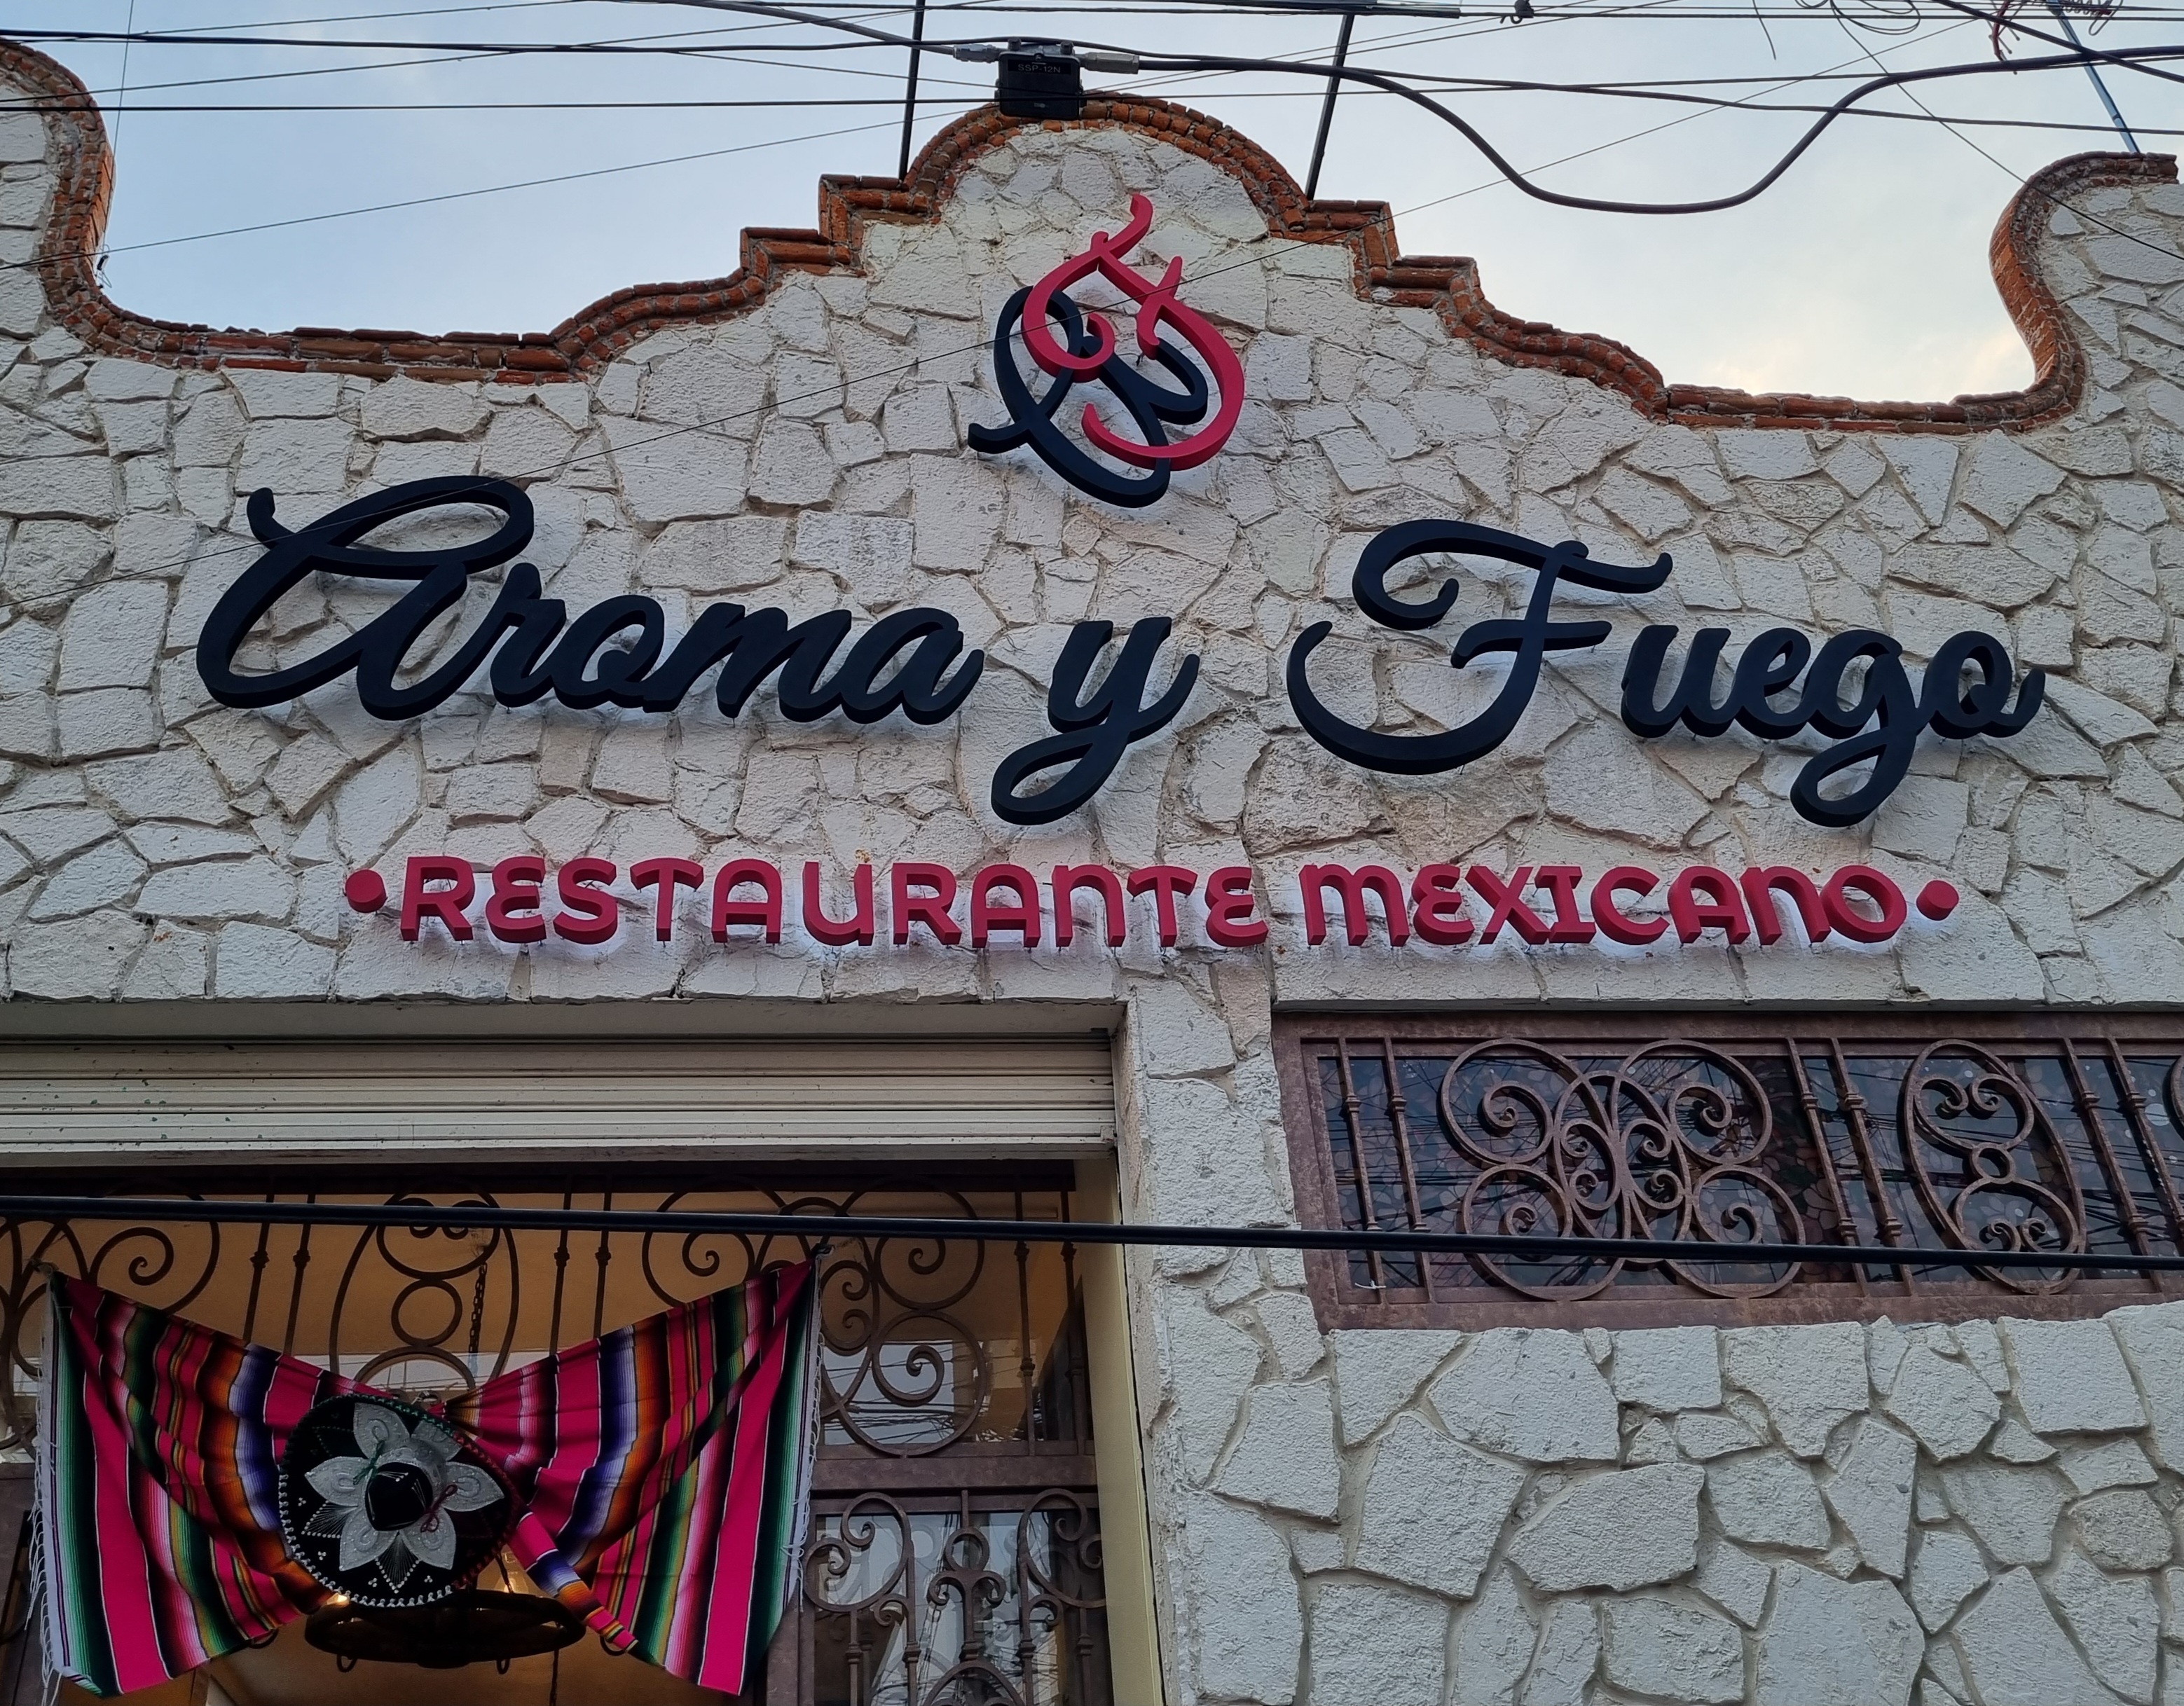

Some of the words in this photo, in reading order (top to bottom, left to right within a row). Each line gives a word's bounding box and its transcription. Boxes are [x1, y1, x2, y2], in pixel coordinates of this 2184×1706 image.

[1017, 63, 1061, 74] SSP-12N
[197, 475, 984, 725] Aroma
[991, 615, 1200, 825] y
[1286, 519, 2046, 829] Fuego
[400, 855, 1269, 947] RESTAURANTE
[1298, 863, 1907, 947] MEXICANO
